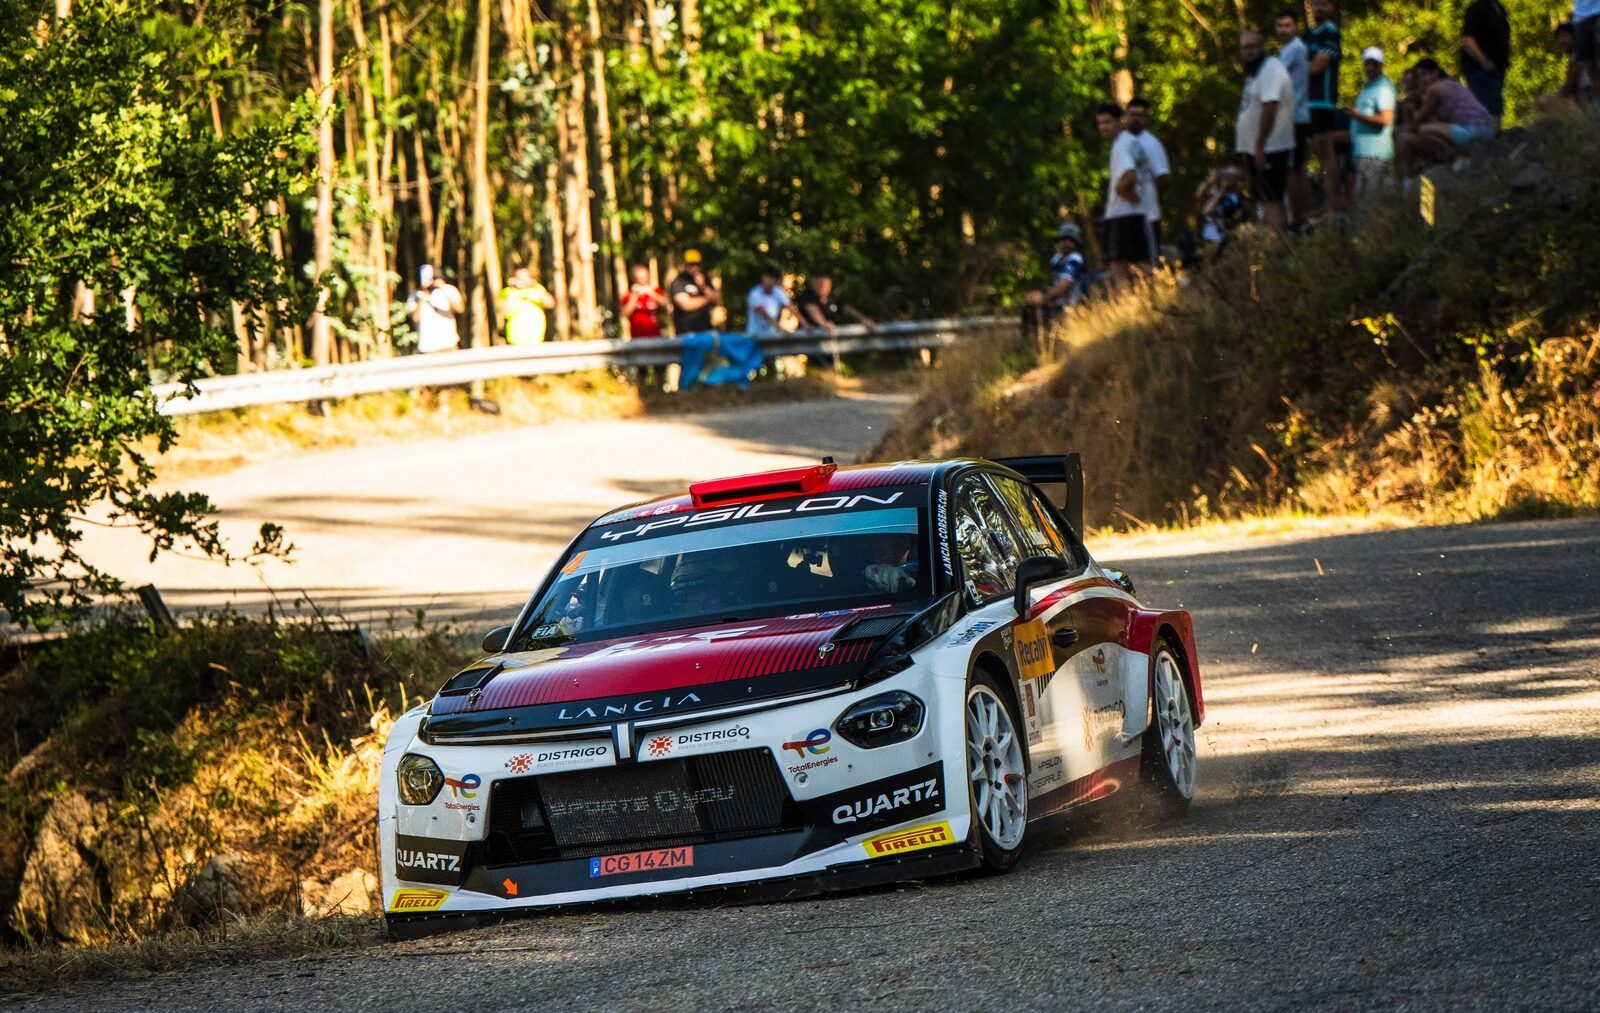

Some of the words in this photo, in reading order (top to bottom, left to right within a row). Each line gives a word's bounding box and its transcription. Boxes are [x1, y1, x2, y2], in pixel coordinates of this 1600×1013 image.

[600, 491, 904, 541] YPSILON
[1018, 633, 1049, 666] Recalvi
[558, 693, 701, 720] LANCIA
[678, 727, 750, 744] DISTRIGO
[538, 746, 607, 762] DISTRIGO
[788, 756, 838, 774] TotalEnergies
[444, 802, 481, 812] TotalEnergies
[832, 778, 939, 825] QUARTZ
[872, 826, 947, 853] PIRELLI
[396, 847, 461, 872] QUARTZ
[605, 856, 630, 873] CG
[394, 893, 445, 909] PIRELLI
